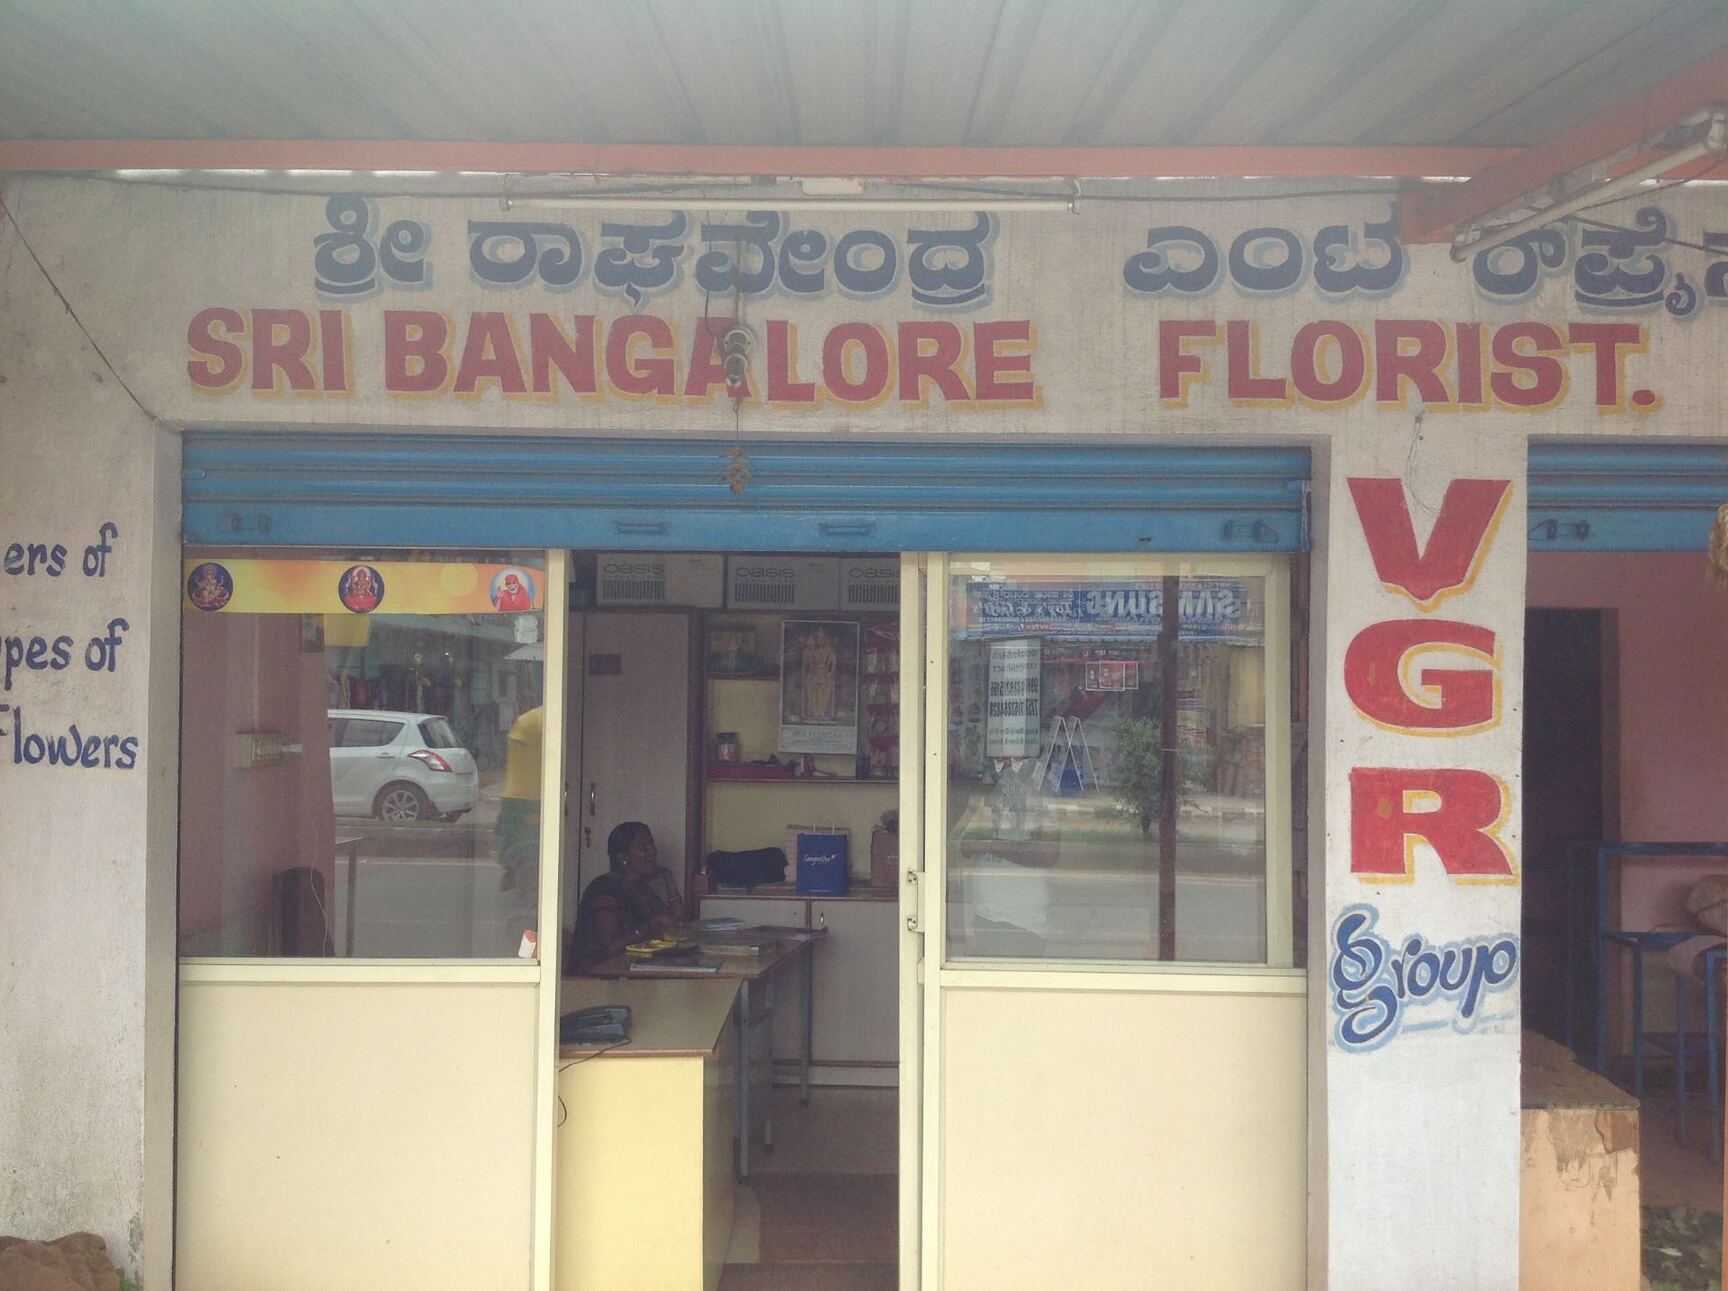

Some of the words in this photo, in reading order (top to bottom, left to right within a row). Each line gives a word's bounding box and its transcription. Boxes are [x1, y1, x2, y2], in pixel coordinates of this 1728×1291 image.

[187, 307, 352, 396] SRI
[384, 309, 1040, 406] BANGALORE
[1159, 319, 1660, 410] FLORIST.
[82, 521, 118, 577] of
[849, 567, 901, 579] oasi
[0, 635, 75, 691] pes
[84, 618, 130, 672] of
[1331, 906, 1518, 1049] Group
